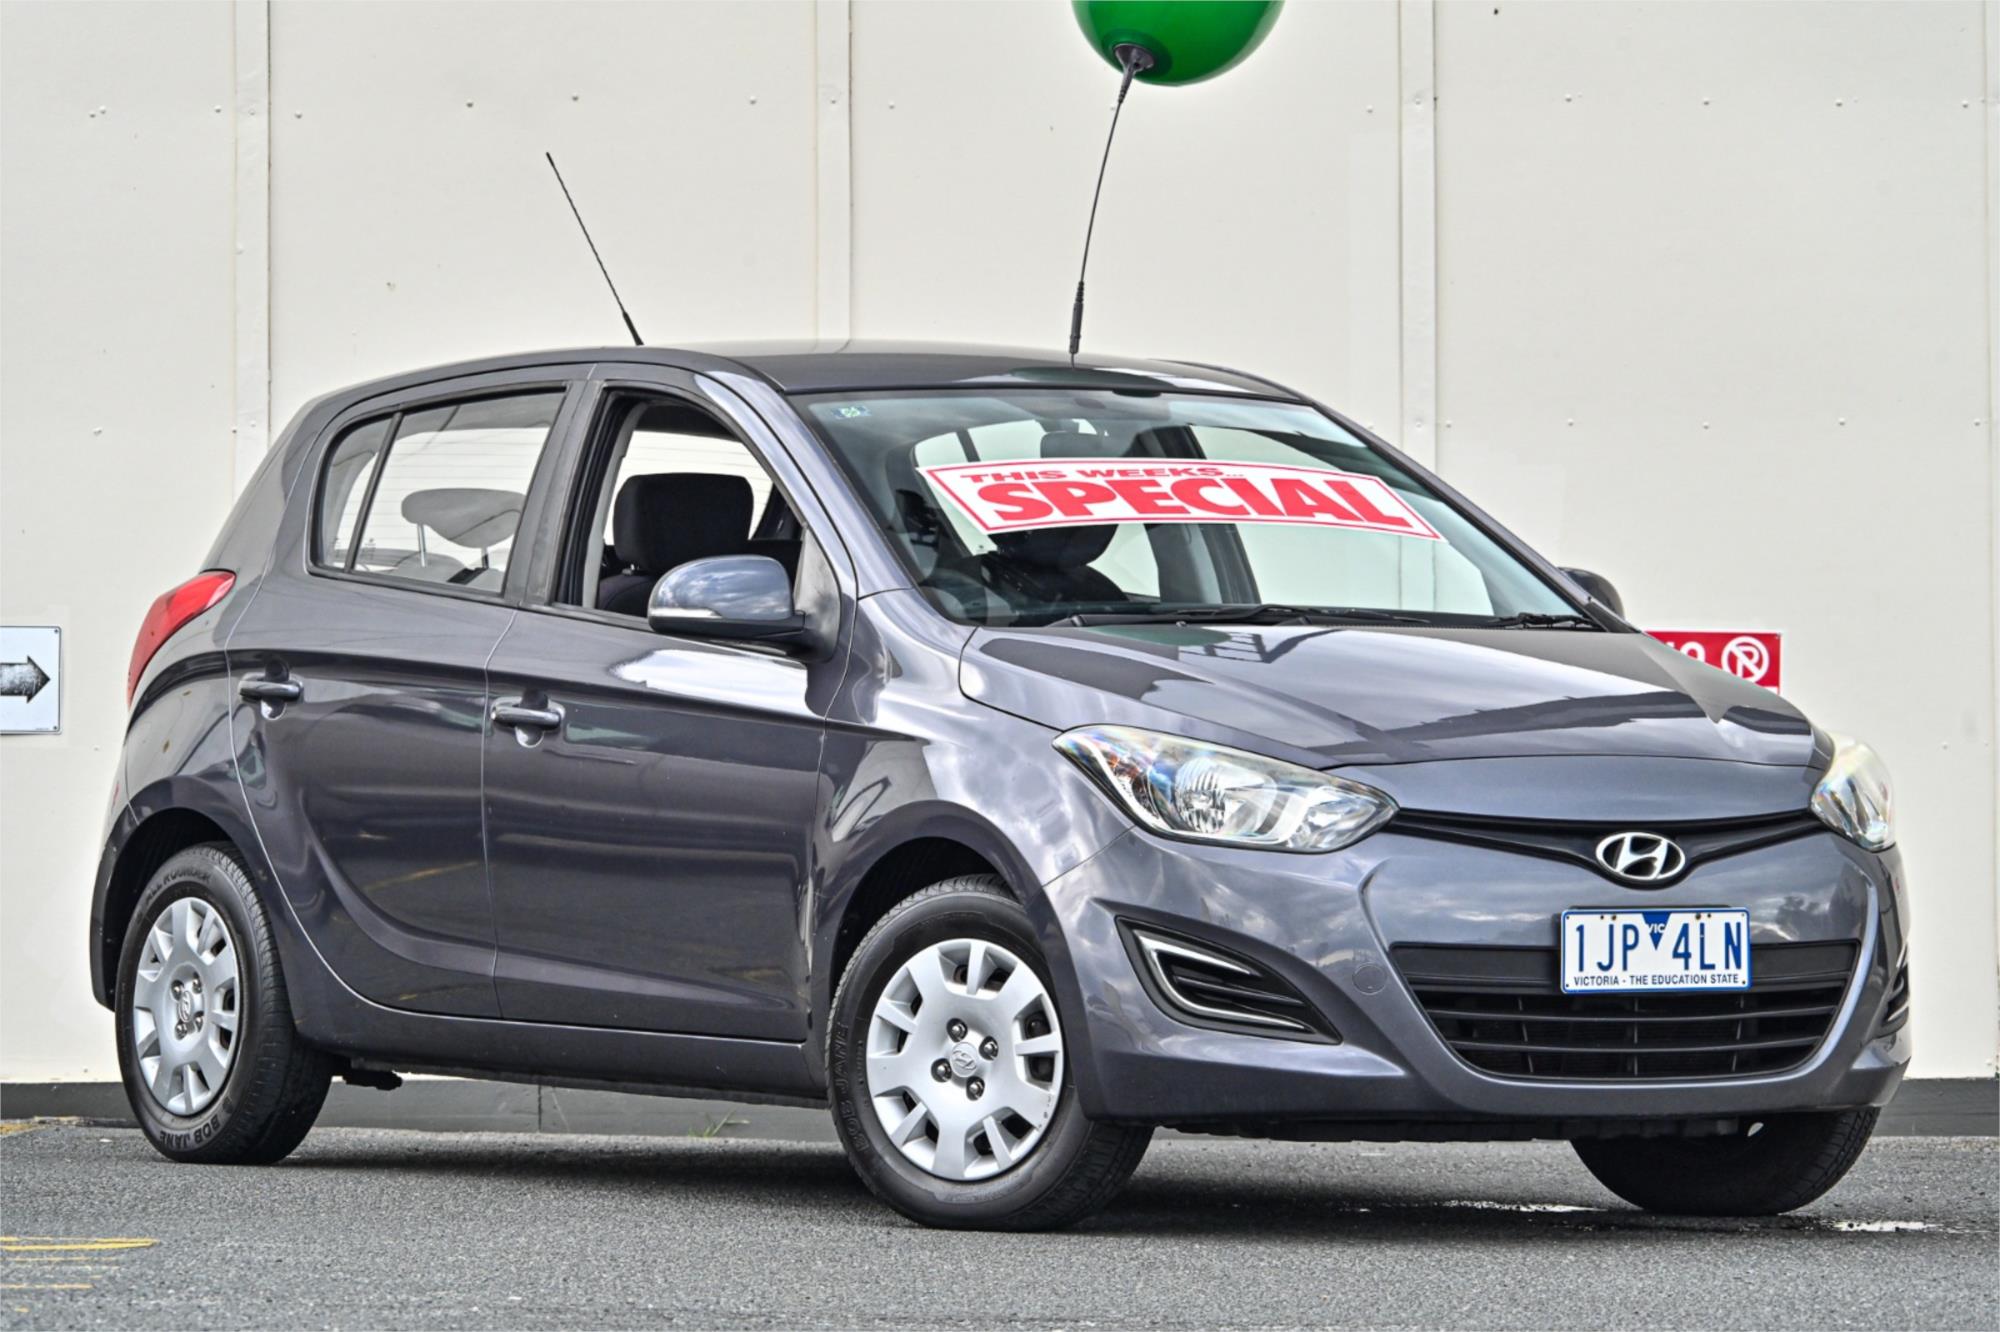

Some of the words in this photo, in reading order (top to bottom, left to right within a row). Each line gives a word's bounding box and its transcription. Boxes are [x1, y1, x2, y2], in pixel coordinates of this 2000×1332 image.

[960, 470, 1067, 483] THIS
[977, 478, 1412, 528] SPECIAL
[1648, 922, 1665, 934] VIC
[1576, 923, 1640, 972] 1JP
[1672, 921, 1742, 971] 4LN
[1573, 976, 1620, 987] VICTORIA
[1630, 975, 1649, 986] THE
[1651, 974, 1708, 985] EDUCATION
[1710, 973, 1739, 984] STATE
[193, 1114, 220, 1145] BOB
